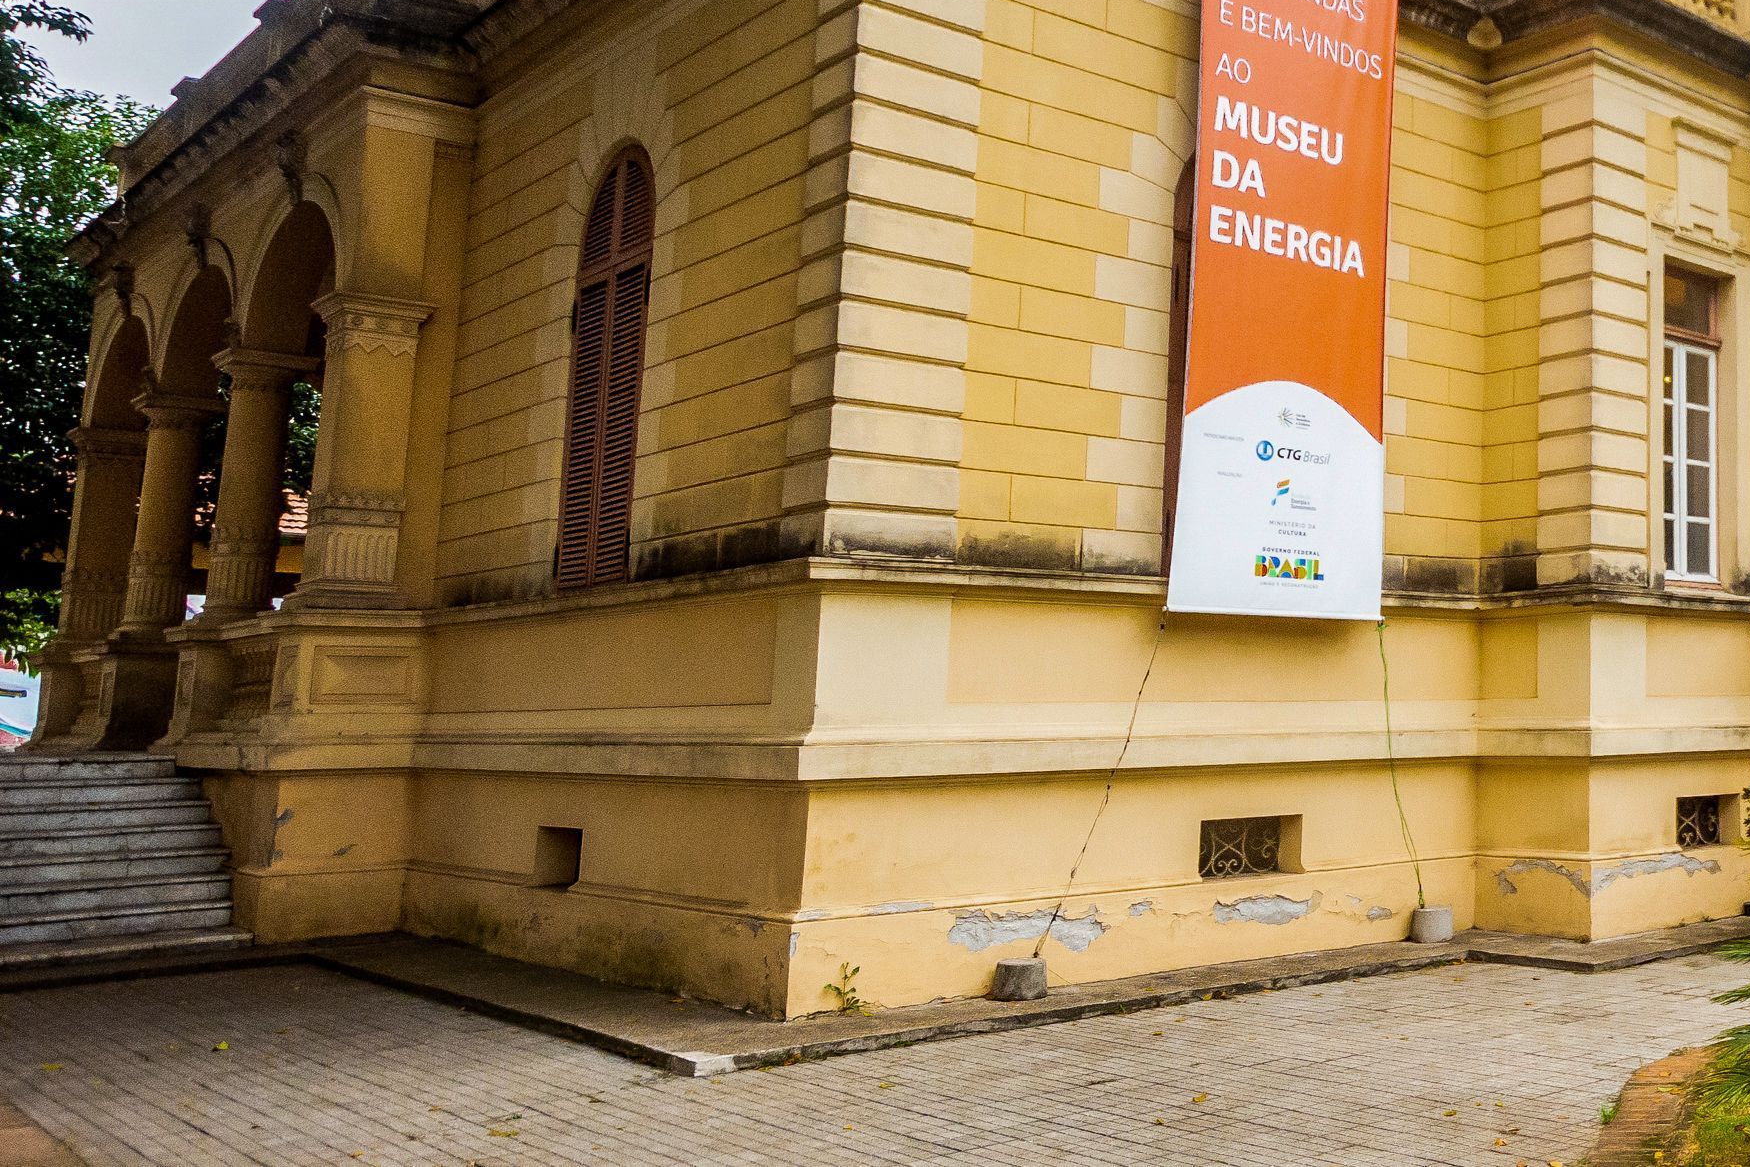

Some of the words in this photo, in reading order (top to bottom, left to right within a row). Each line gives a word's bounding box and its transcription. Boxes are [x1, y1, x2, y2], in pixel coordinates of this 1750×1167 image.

[1241, 3, 1383, 80] BEM-VINDOS
[1215, 52, 1251, 84] AO
[1213, 95, 1344, 166] MUSEU
[1211, 149, 1267, 198] DA
[1209, 204, 1365, 278] ENERGIA
[1277, 447, 1302, 461] CTG
[1303, 450, 1331, 465] Brasil
[1278, 529, 1306, 537] CULTURA
[1254, 554, 1324, 581] BRASIL
[1262, 546, 1291, 554] GOVERNO
[1294, 549, 1320, 557] FEDERAL
